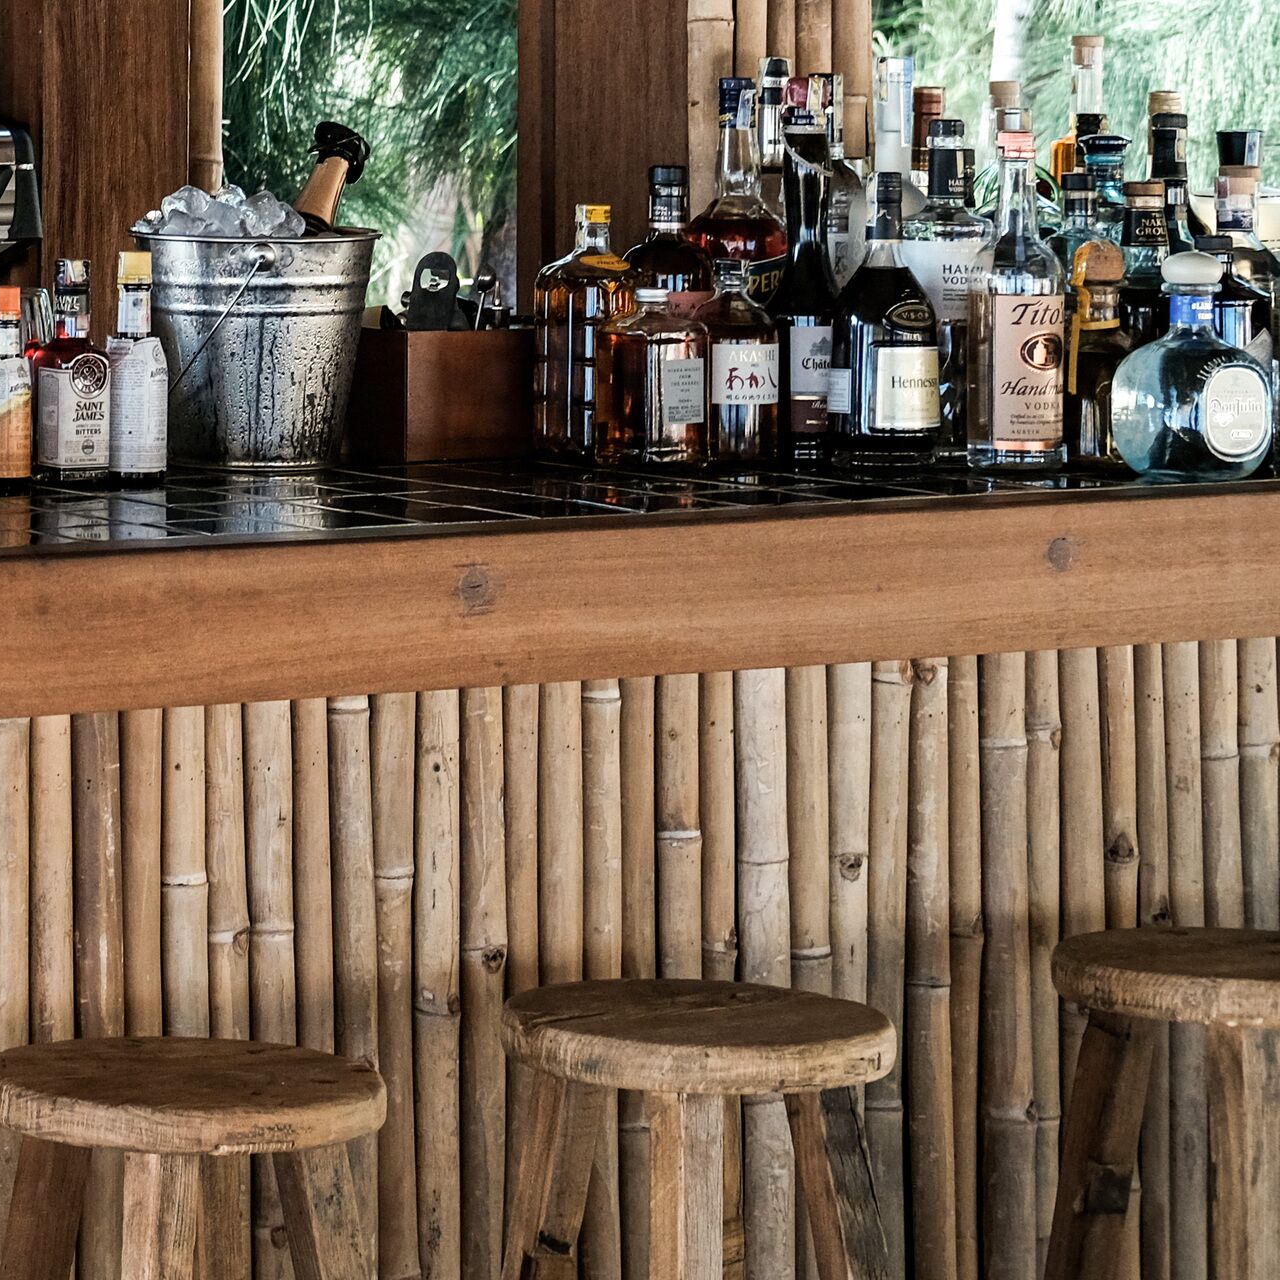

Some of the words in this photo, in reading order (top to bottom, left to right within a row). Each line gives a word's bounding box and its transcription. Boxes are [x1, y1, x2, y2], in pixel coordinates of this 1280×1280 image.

[729, 349, 776, 362] AKASHI
[725, 367, 777, 391] あかし
[75, 401, 105, 412] SAINT
[72, 410, 105, 423] JAMES
[75, 428, 102, 436] BITTERS
